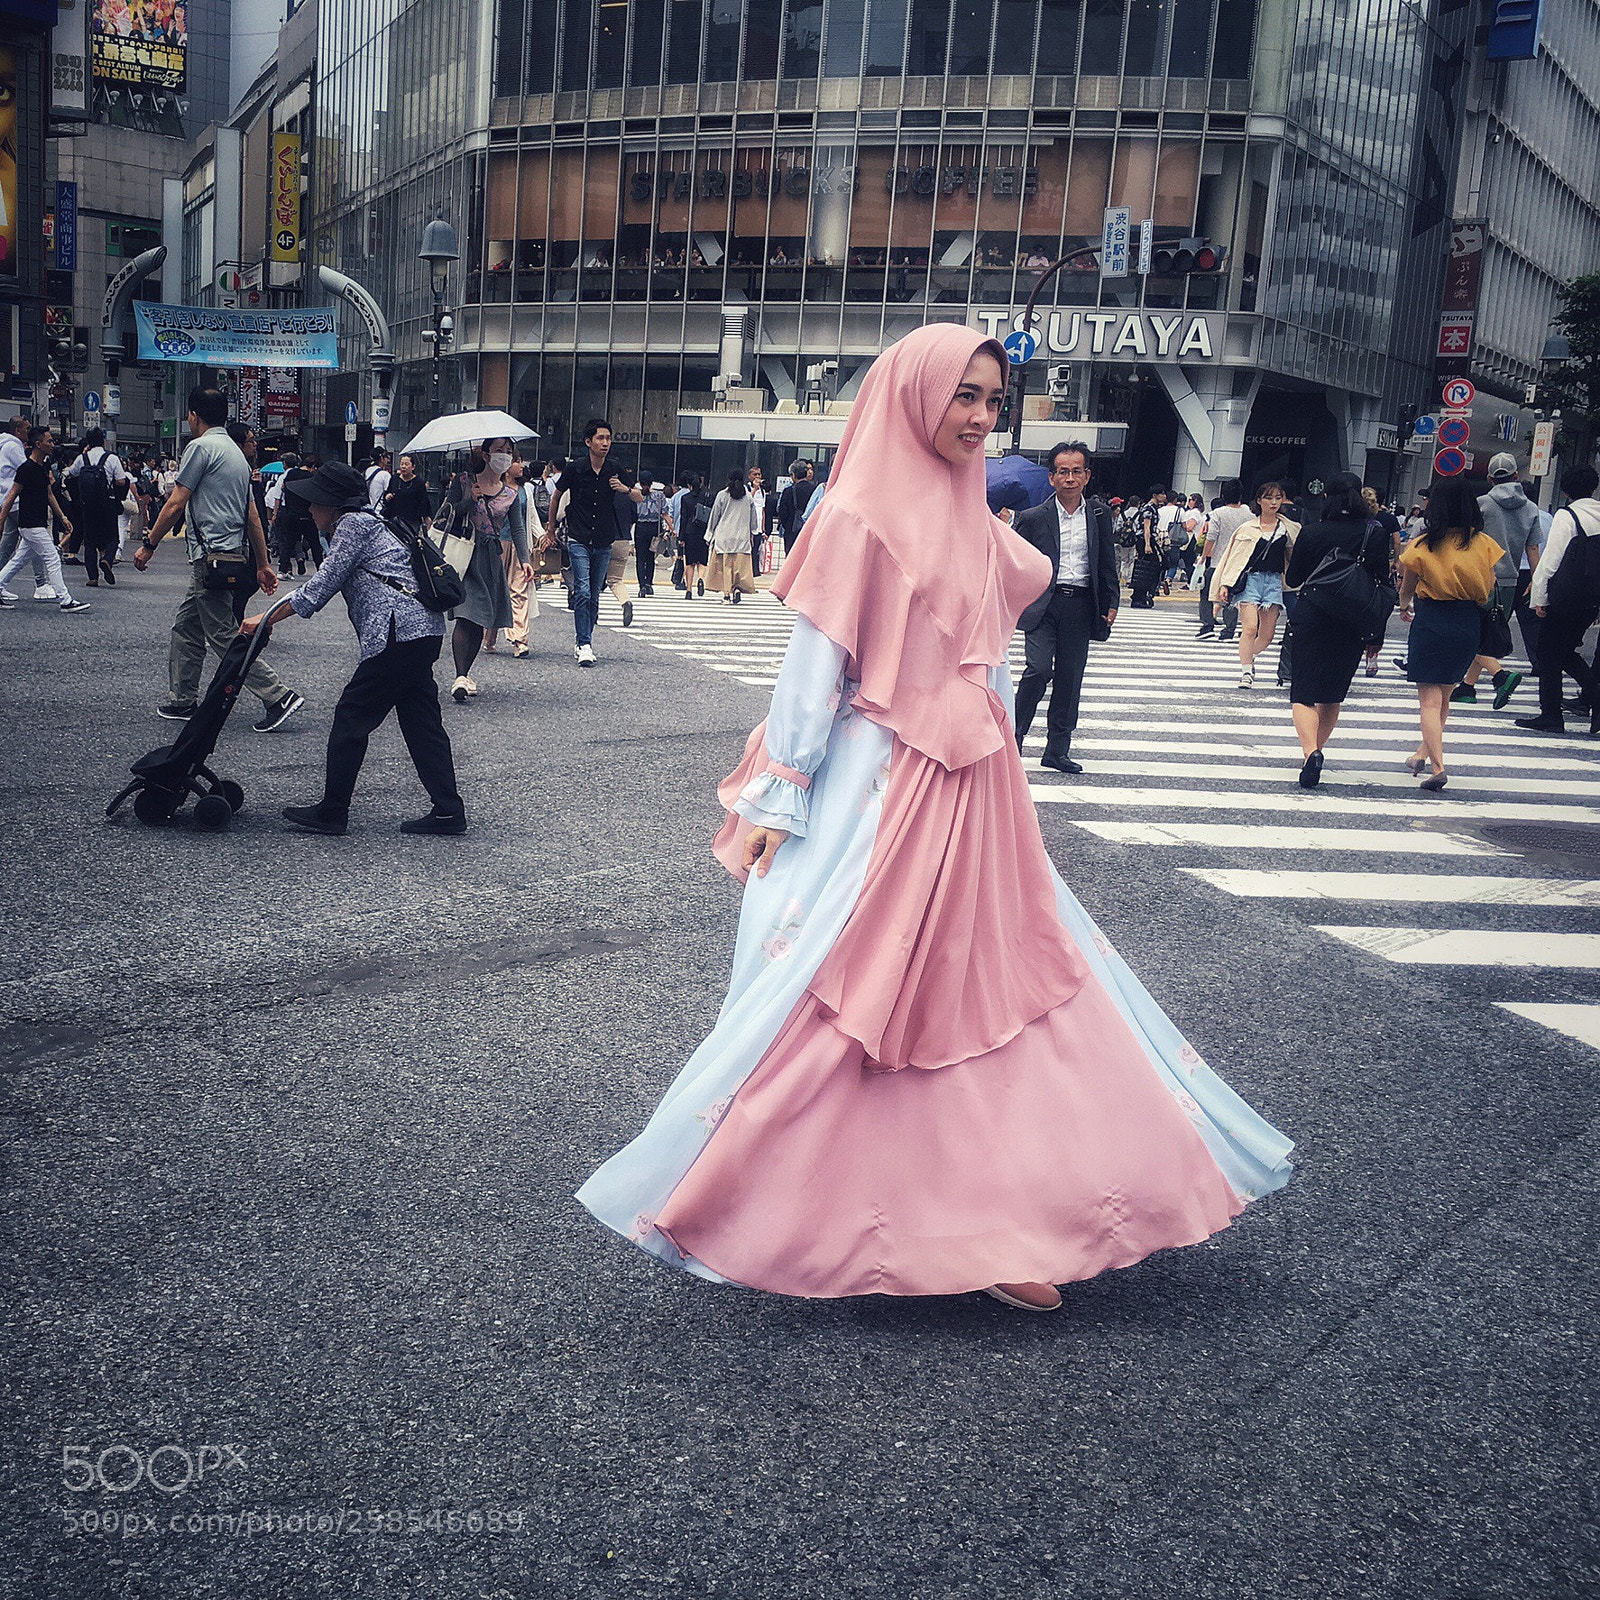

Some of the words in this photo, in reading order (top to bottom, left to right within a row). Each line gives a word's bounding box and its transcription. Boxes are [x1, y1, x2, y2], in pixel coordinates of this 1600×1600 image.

[92, 66, 110, 78] ON
[112, 69, 141, 83] SALE
[117, 63, 141, 72] ALBUM
[630, 165, 859, 200] STARBUCKS
[886, 165, 1040, 195] COFFEE
[277, 237, 294, 248] 4F
[1105, 222, 1114, 249] Shibuya
[1112, 212, 1127, 271] 渋谷駅前
[978, 311, 1214, 356] TSUTAYA
[1444, 329, 1467, 350] 本
[1267, 436, 1307, 445] COFFEE
